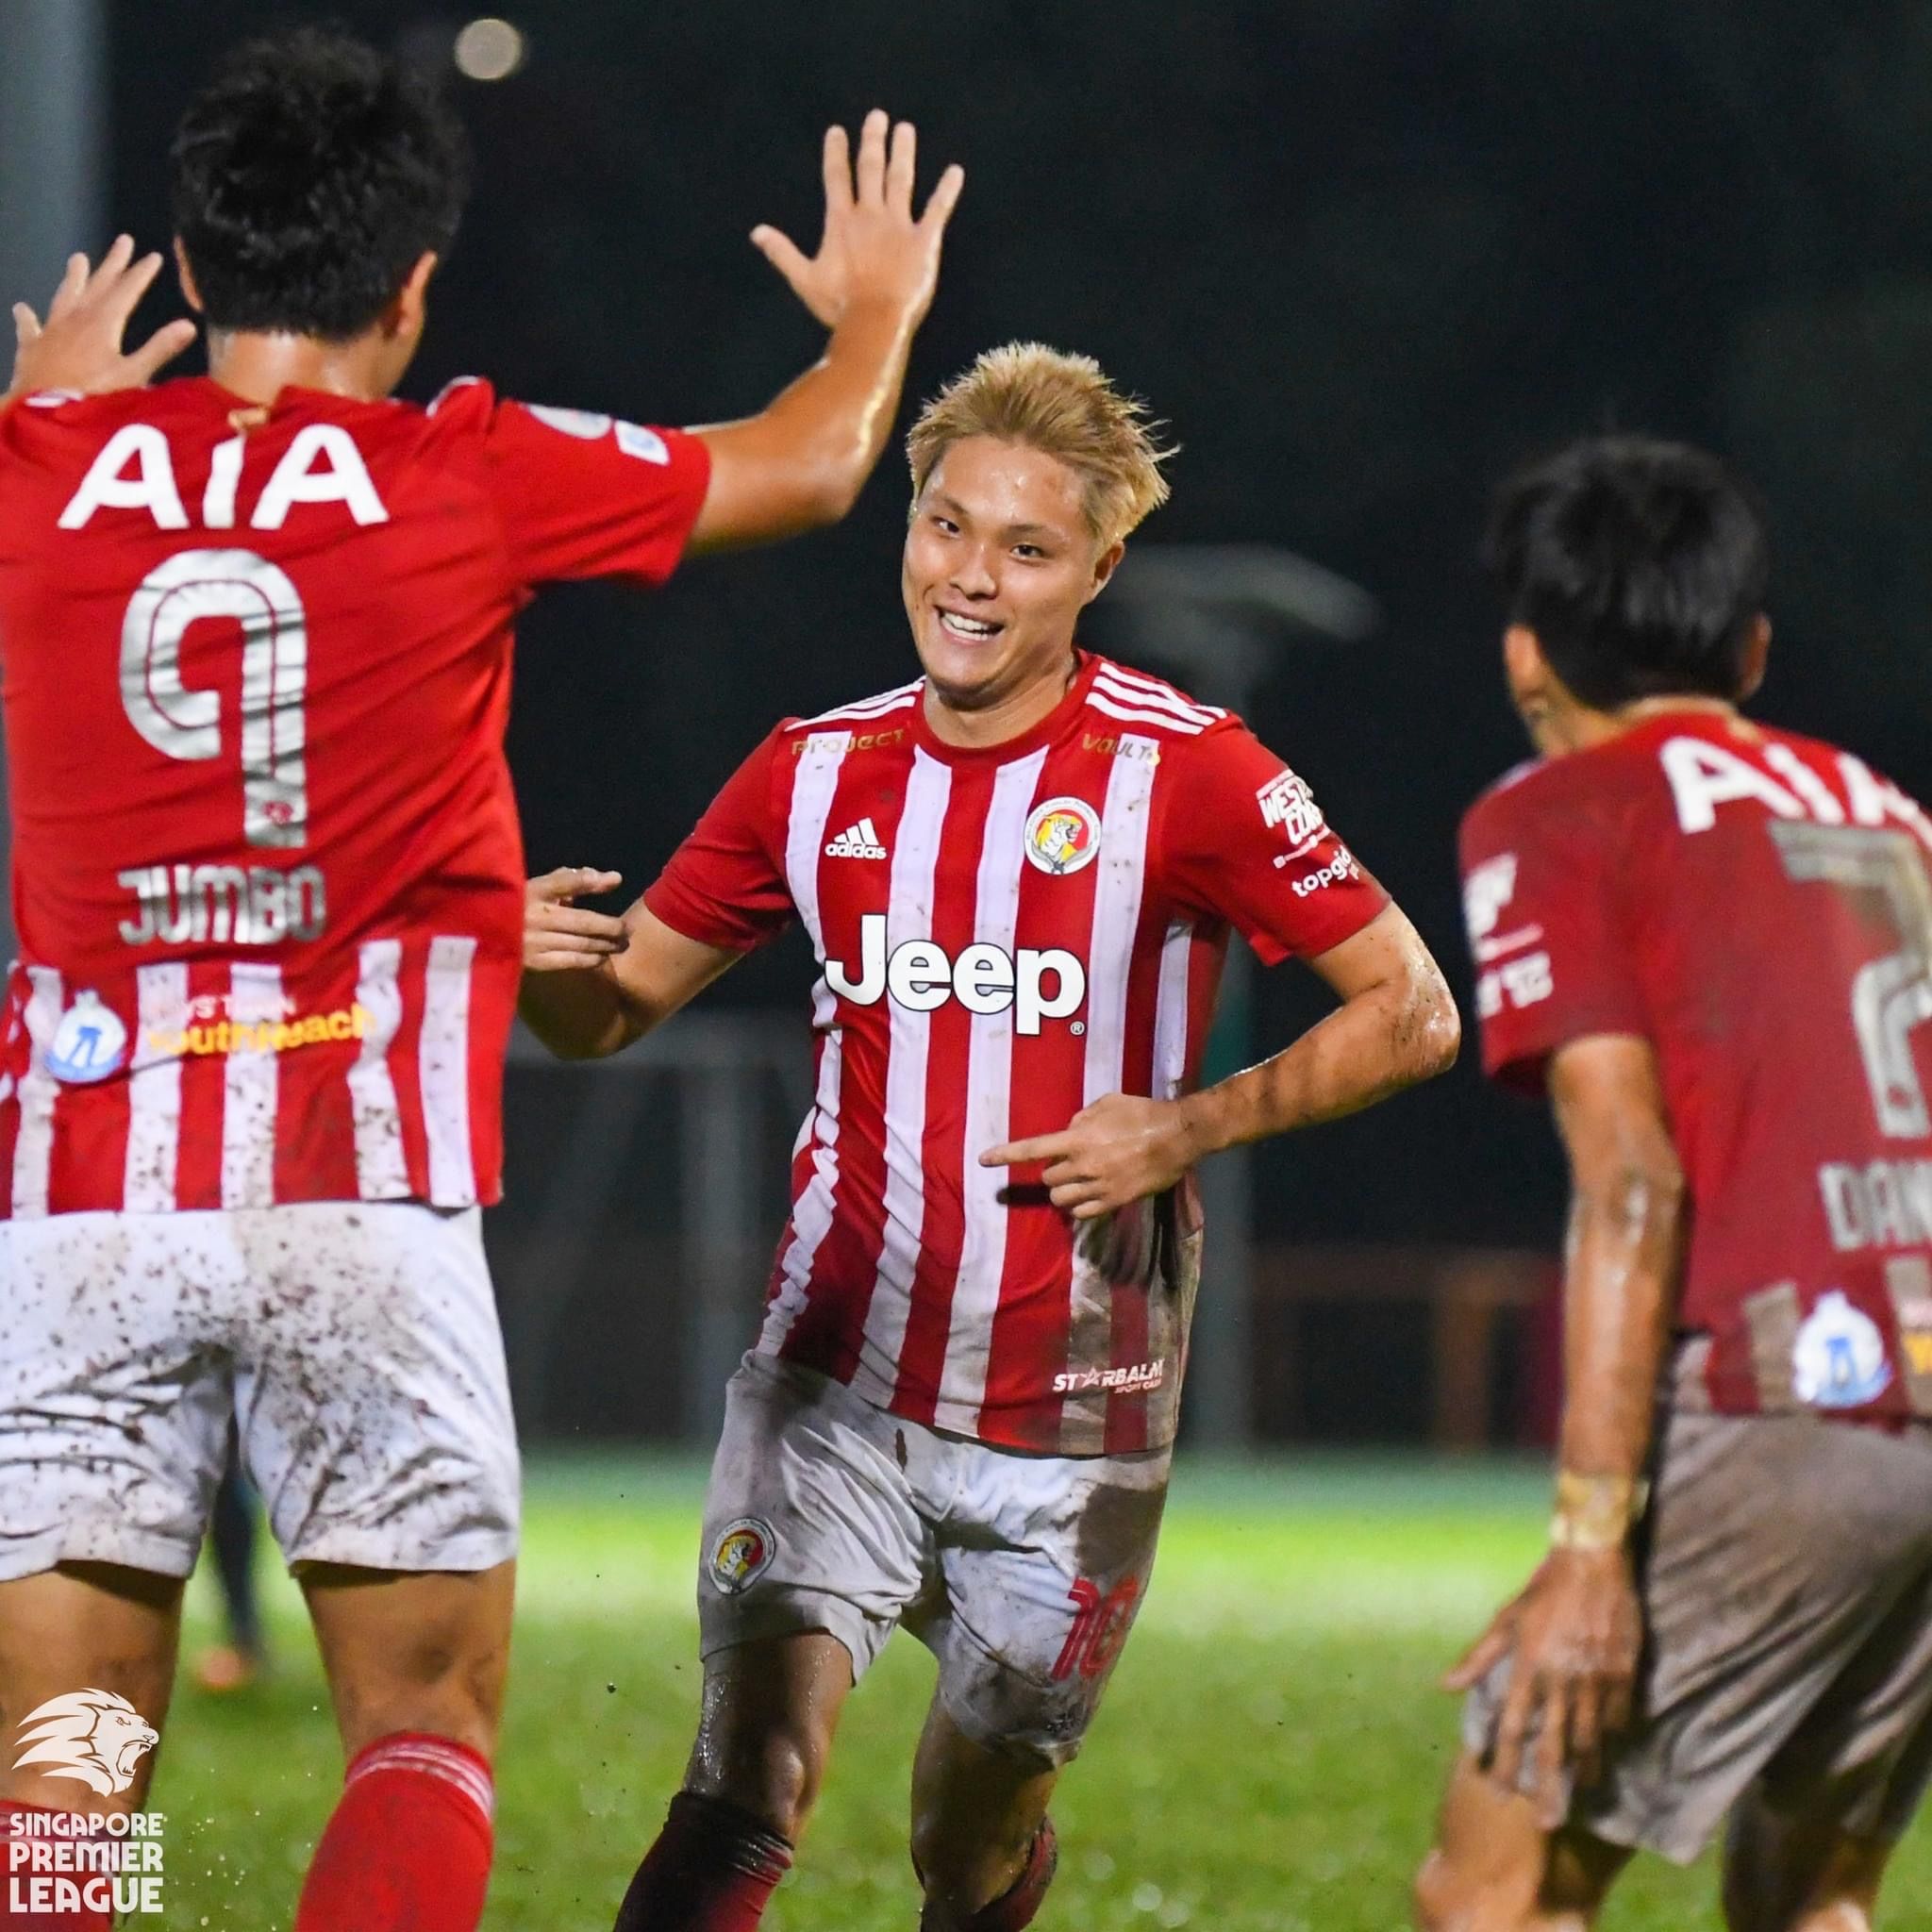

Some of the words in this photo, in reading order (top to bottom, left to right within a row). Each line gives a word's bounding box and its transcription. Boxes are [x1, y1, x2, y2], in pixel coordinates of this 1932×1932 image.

[58, 423, 389, 530] AIA
[119, 548, 308, 849] 9
[1658, 736, 1932, 850] AIA
[118, 863, 326, 944] JUMBO
[825, 841, 887, 859] adidas
[824, 913, 1086, 1035] Jeep
